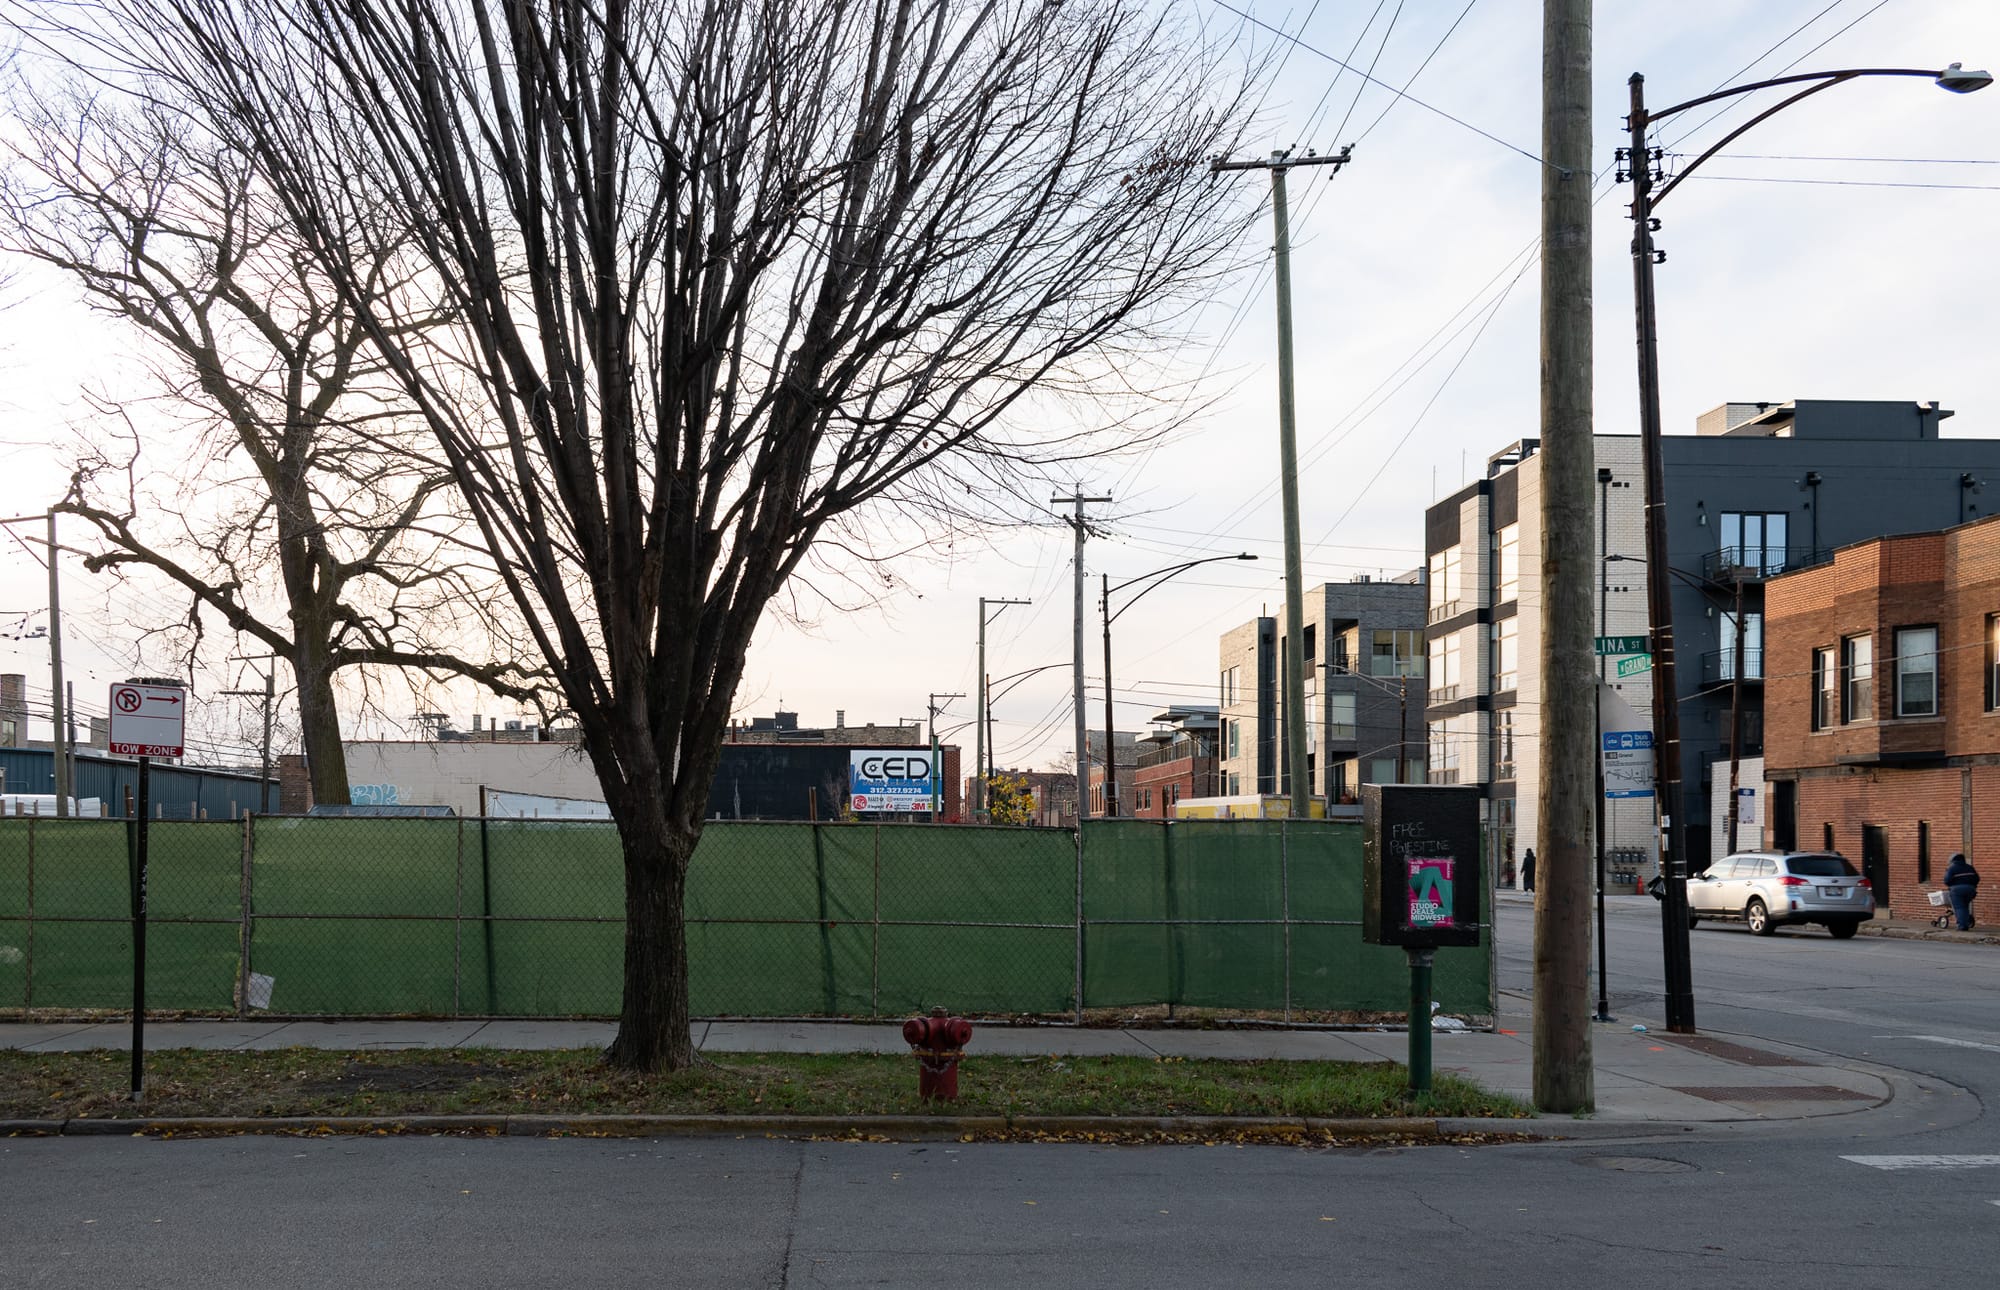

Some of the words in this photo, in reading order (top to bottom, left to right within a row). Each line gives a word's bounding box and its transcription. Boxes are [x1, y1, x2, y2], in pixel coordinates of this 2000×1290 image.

[1631, 640, 1641, 649] ST
[1624, 656, 1647, 674] GRAND
[114, 744, 139, 754] TOW
[145, 745, 177, 756] ZONE
[861, 757, 930, 779] CED
[1392, 822, 1424, 838] FREE
